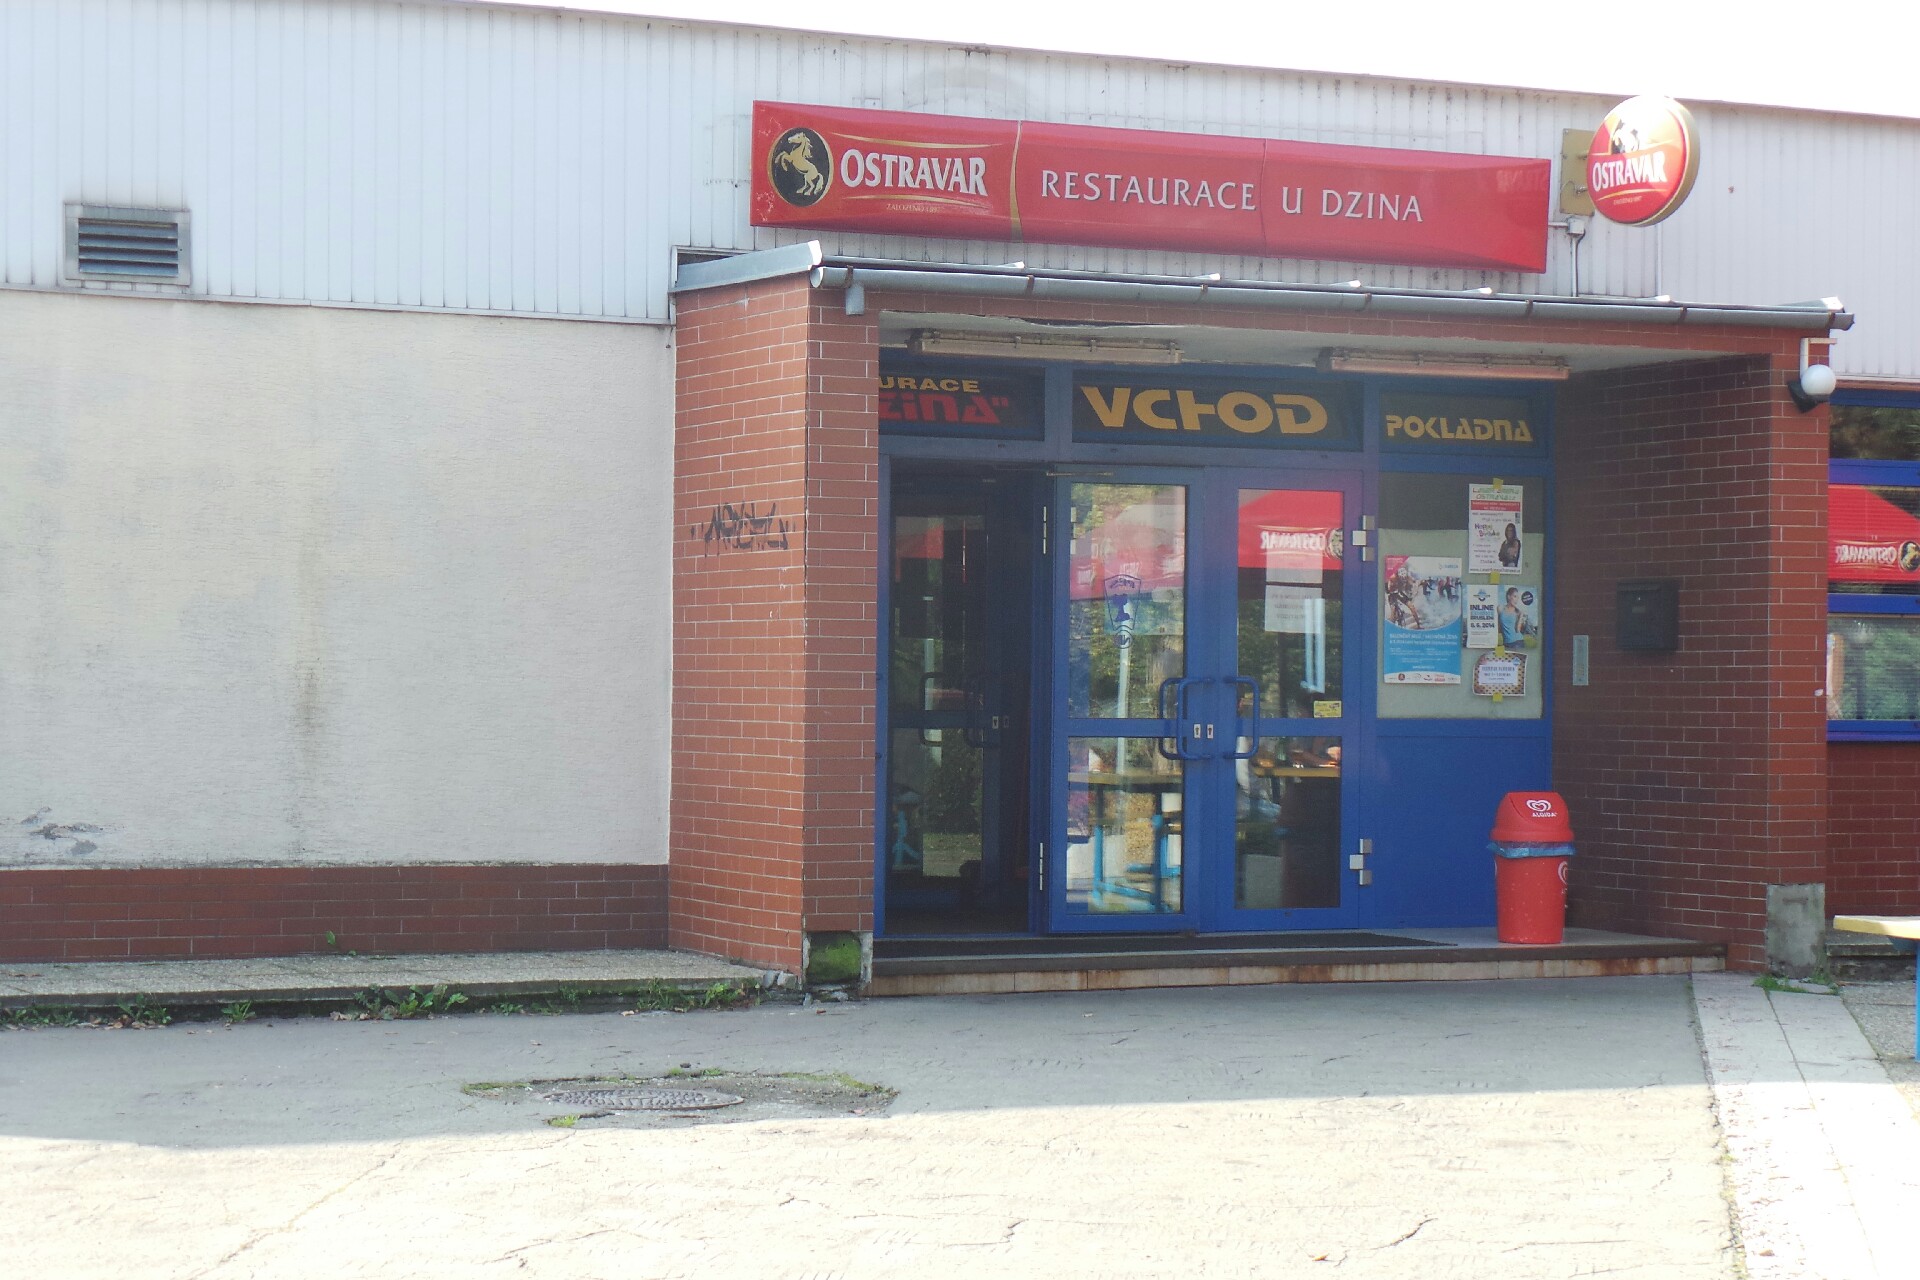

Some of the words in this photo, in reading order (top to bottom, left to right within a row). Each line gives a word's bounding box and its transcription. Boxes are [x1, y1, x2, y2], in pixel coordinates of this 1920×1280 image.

[841, 149, 988, 196] OSTRAVAR
[1592, 151, 1668, 192] OSTRAVAR
[1042, 170, 1256, 210] RESTAURACE
[1282, 186, 1302, 214] U
[1321, 189, 1423, 222] DZINA
[1080, 386, 1328, 434] VCHOD
[1386, 415, 1533, 441] POKLADNA
